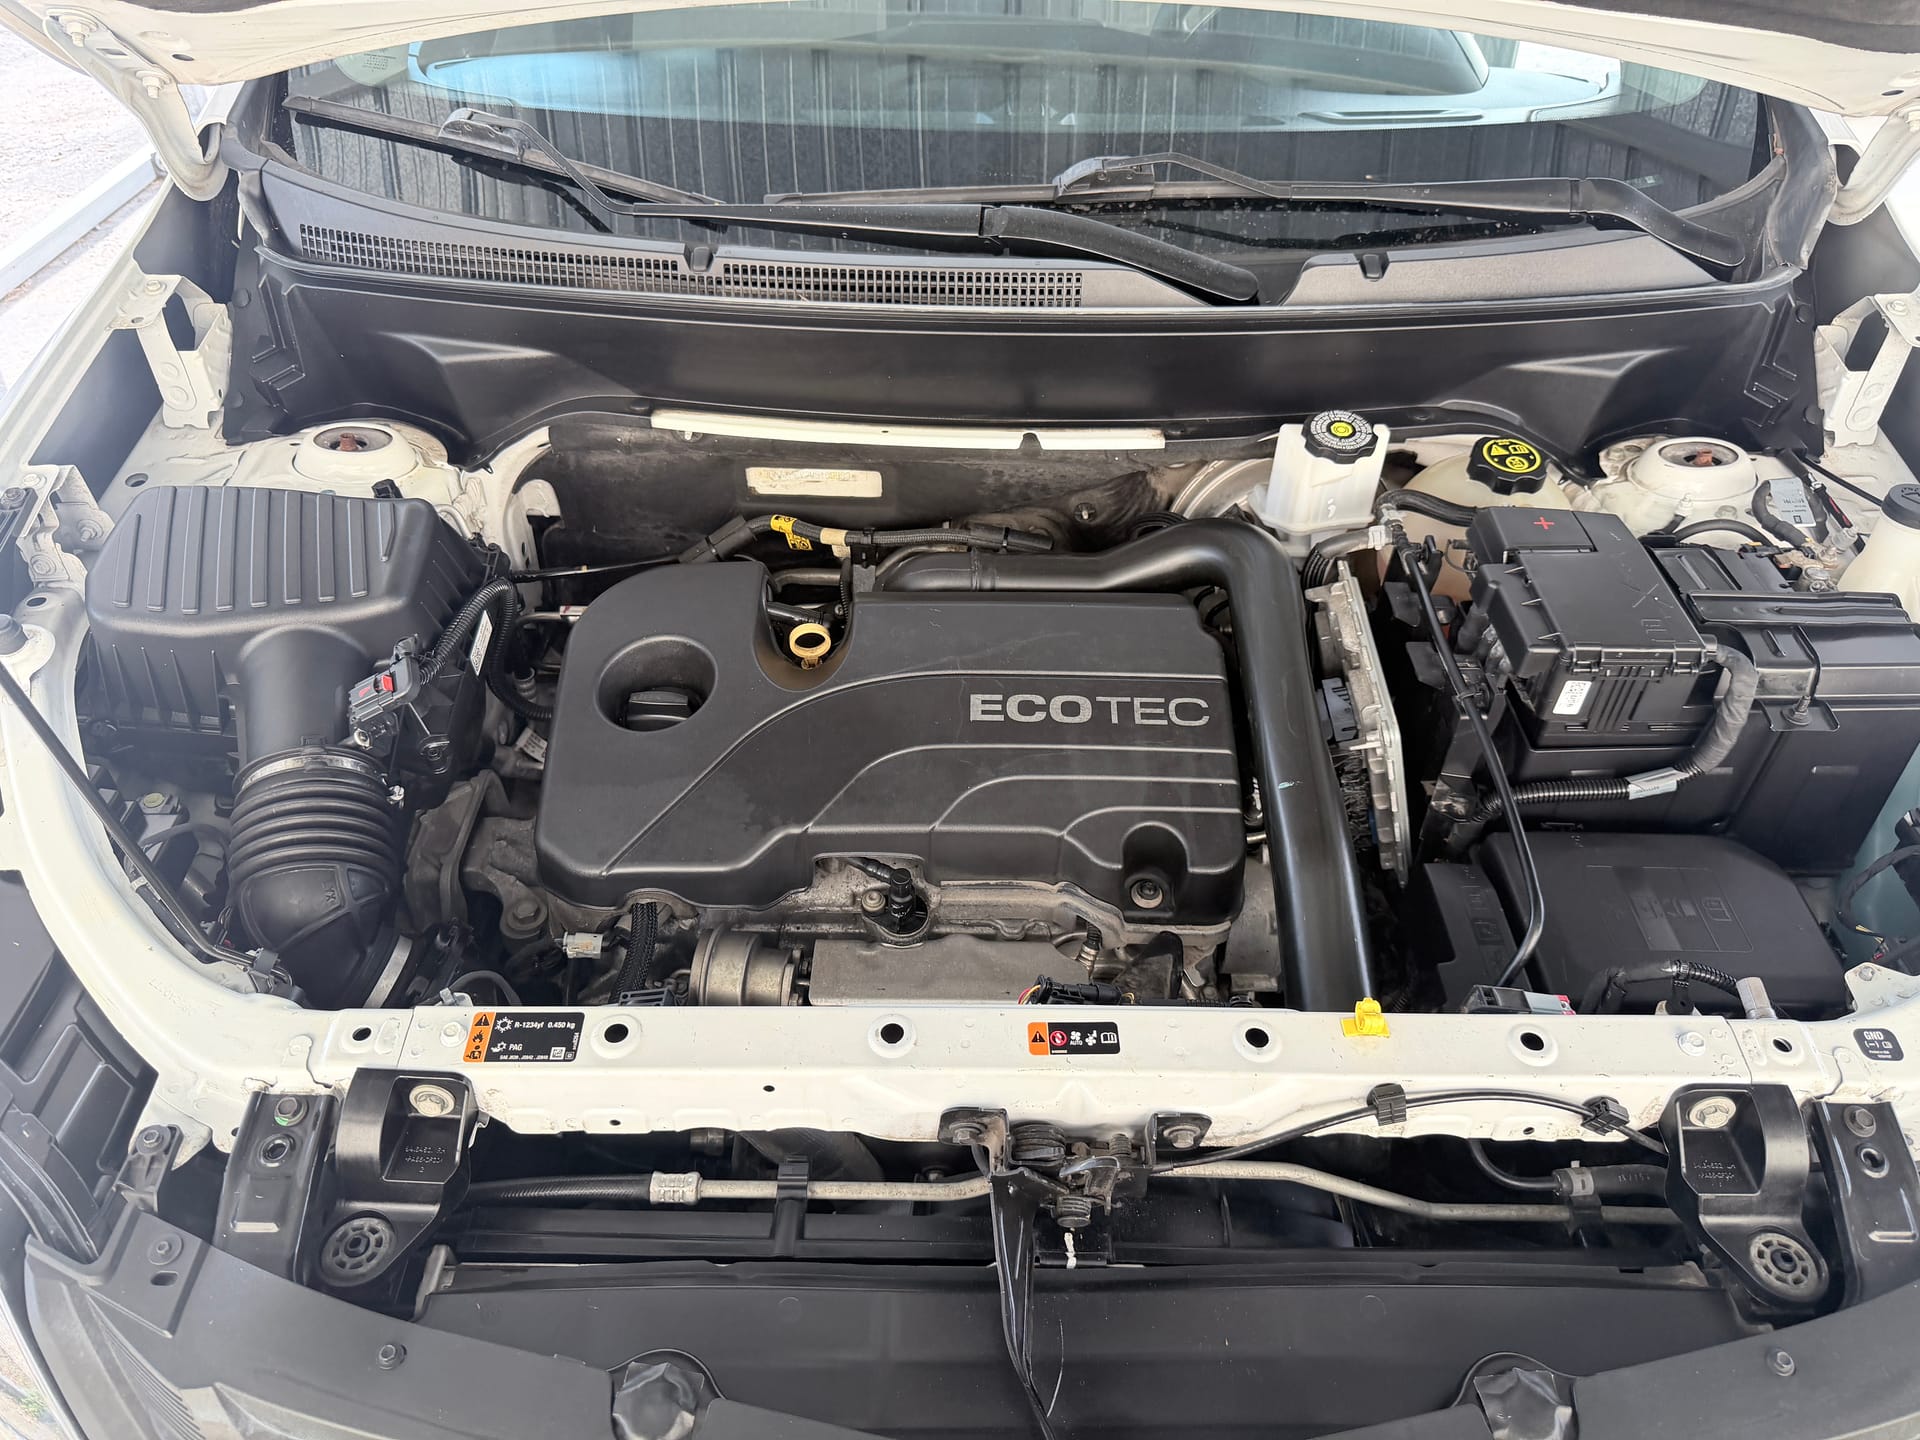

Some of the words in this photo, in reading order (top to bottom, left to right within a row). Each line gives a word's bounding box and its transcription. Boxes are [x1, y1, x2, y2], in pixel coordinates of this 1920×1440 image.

[969, 693, 1210, 727] ECOTEC
[514, 1021, 544, 1030] R-1234yf
[1863, 1031, 1884, 1041] GND
[508, 1043, 523, 1051] PAG
